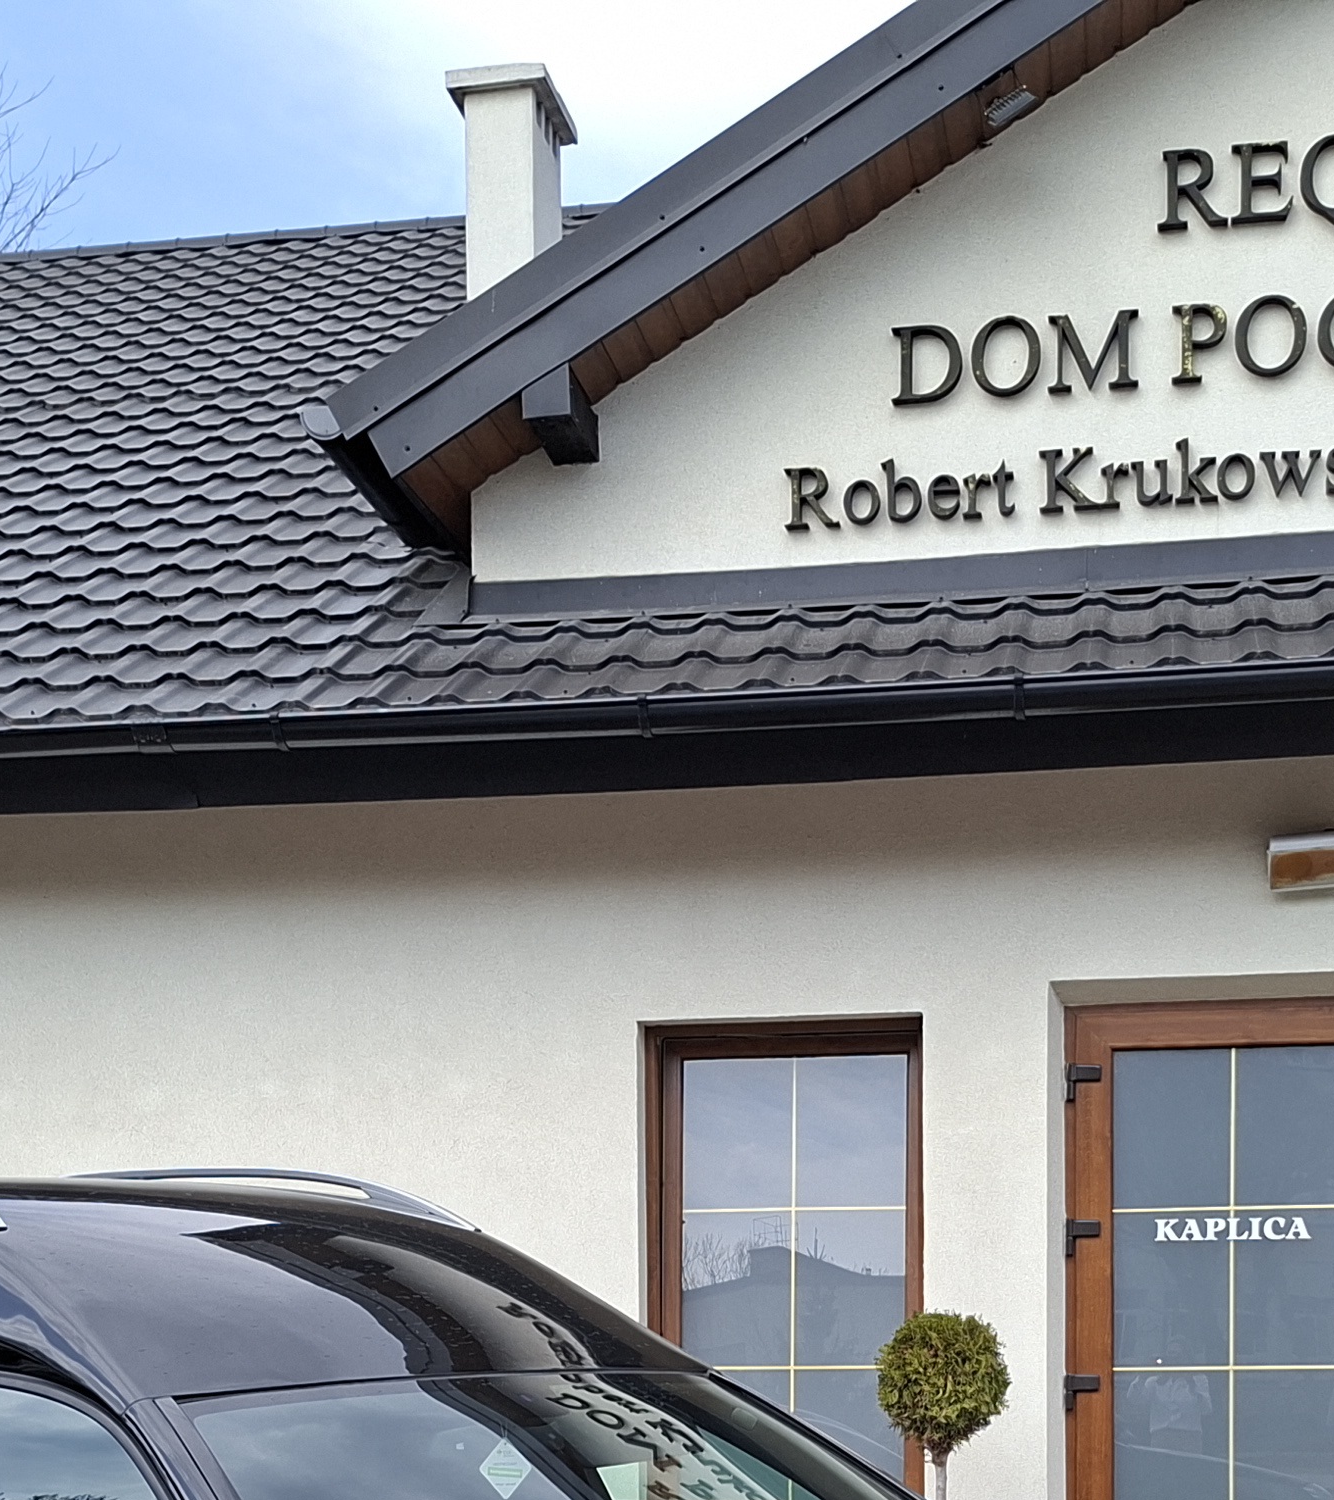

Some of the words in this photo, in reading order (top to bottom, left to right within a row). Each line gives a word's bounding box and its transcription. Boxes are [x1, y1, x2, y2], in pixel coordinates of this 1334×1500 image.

[891, 308, 1140, 409] DOM
[783, 457, 1016, 532] Robert
[1154, 1216, 1312, 1242] KAPLICA
